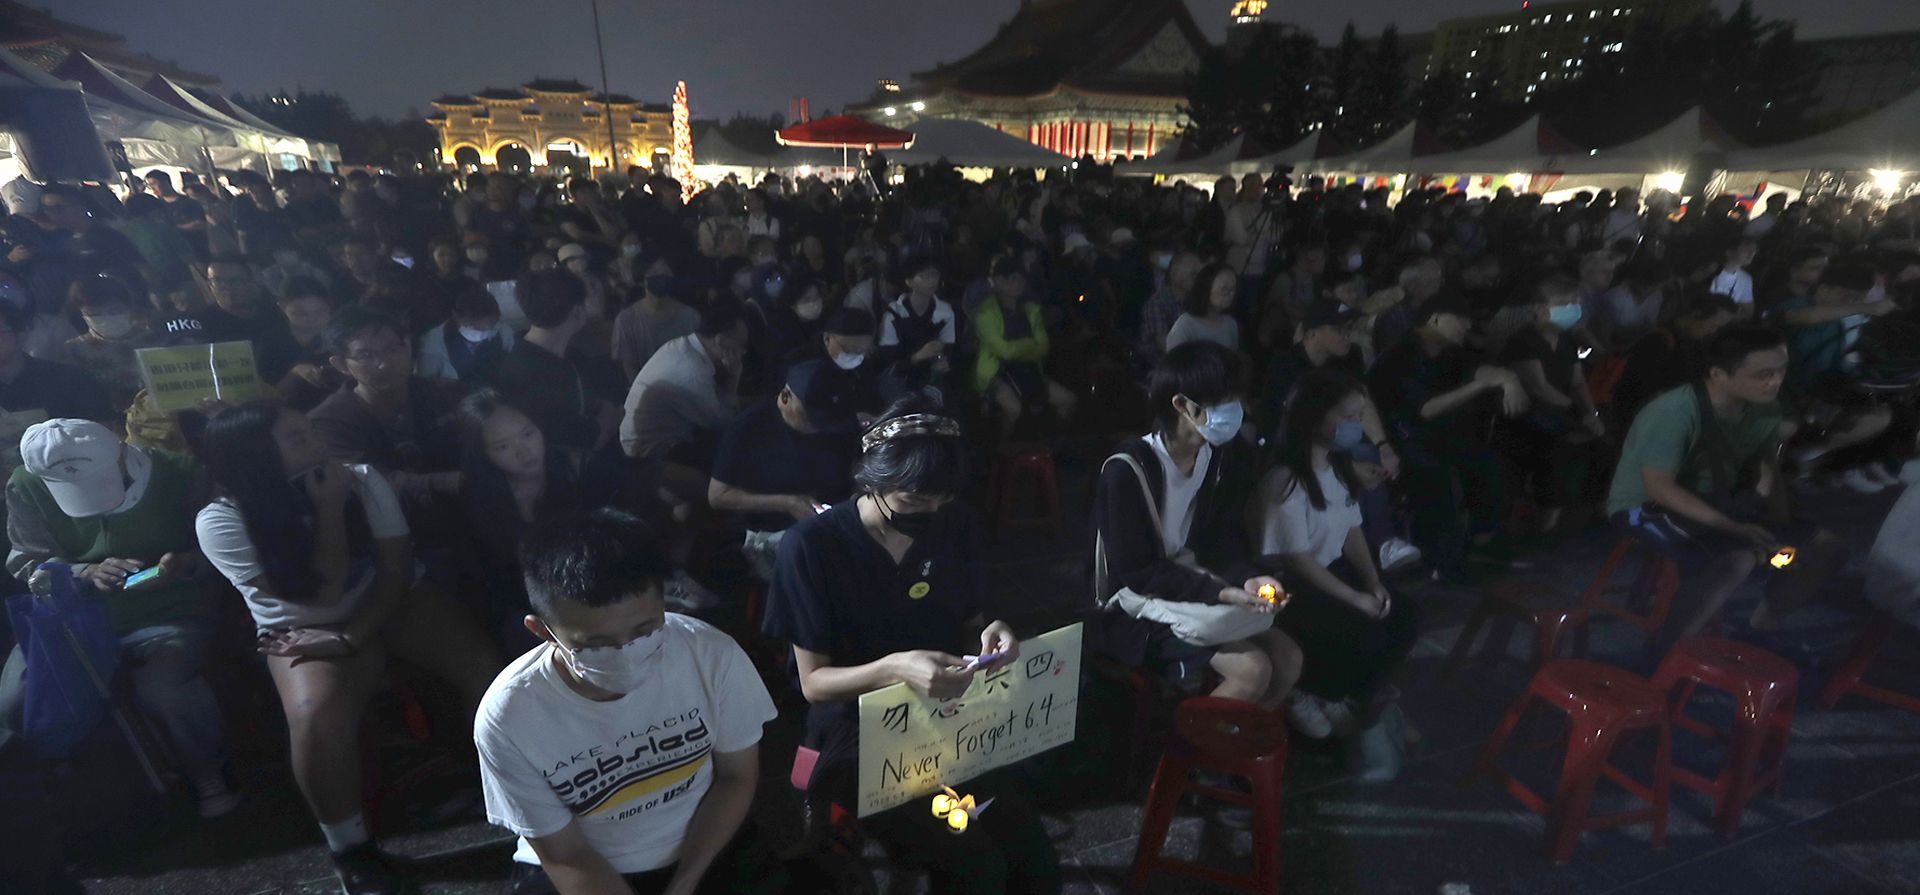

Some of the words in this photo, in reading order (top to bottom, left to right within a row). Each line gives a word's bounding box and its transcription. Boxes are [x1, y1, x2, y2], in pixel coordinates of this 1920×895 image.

[166, 318, 202, 333] HKG
[543, 745, 603, 778] LAKE
[615, 707, 700, 748] PLACID
[880, 752, 943, 789] Never
[955, 709, 1020, 760] Forget
[1024, 693, 1054, 728] 6.4
[619, 805, 643, 820] RIDE
[645, 799, 659, 810] OF
